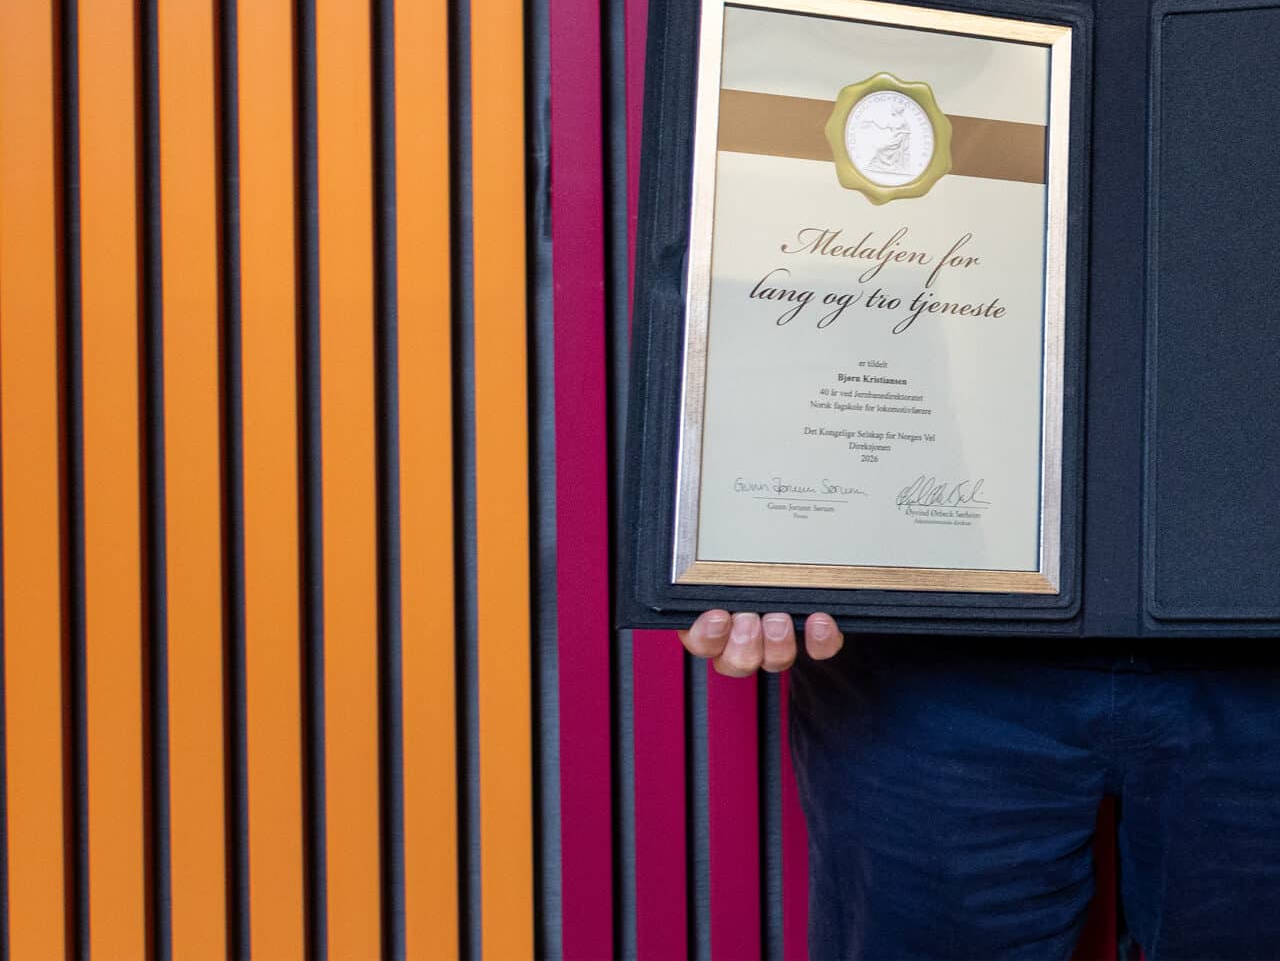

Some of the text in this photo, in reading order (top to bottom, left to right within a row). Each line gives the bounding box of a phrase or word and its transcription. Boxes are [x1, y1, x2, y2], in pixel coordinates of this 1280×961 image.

[781, 227, 981, 288] Medaljen for
[749, 268, 1006, 334] lang og tro tjeneste
[838, 373, 907, 385] Bjørn Kristiansen
[810, 400, 832, 409] Norsk
[833, 401, 863, 411] fagskole
[864, 403, 875, 412] for
[804, 427, 936, 442] Det Kongelige Selskap for Norges Vel
